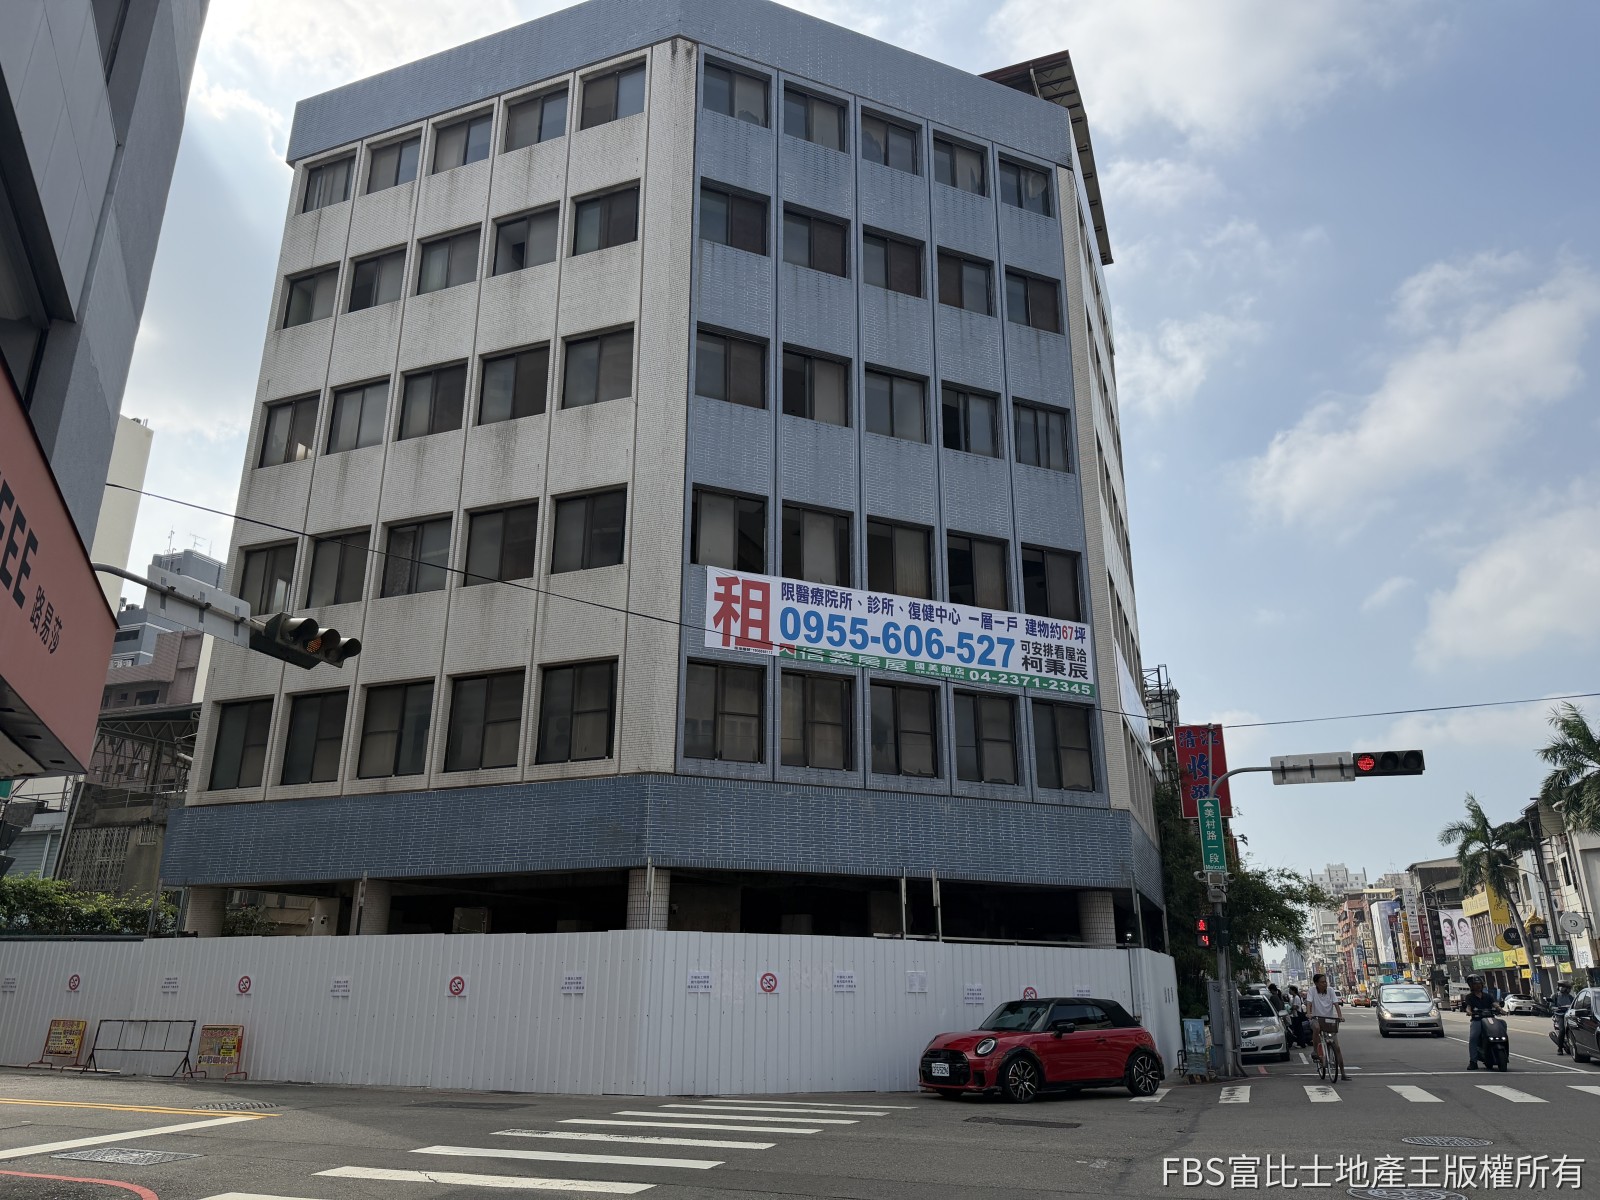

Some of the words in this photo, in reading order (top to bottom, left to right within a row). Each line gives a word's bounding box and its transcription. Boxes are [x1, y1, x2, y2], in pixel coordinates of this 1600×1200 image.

[30, 585, 63, 654] 路易莎
[713, 576, 773, 648] 租
[780, 606, 1015, 668] 0955-606-527
[781, 582, 961, 625] 限醫療院所、診所、復健中心
[968, 612, 1018, 632] 一層一戶
[1025, 618, 1087, 644] 建物約67坪
[799, 647, 908, 672] 信義房屋
[914, 661, 965, 675] 國美館店
[1020, 640, 1087, 663] 可安排看屋洽
[1021, 655, 1089, 680] 柯秉辰
[969, 670, 1091, 695] 04-2371-2345
[1204, 808, 1220, 863] 美村路一段
